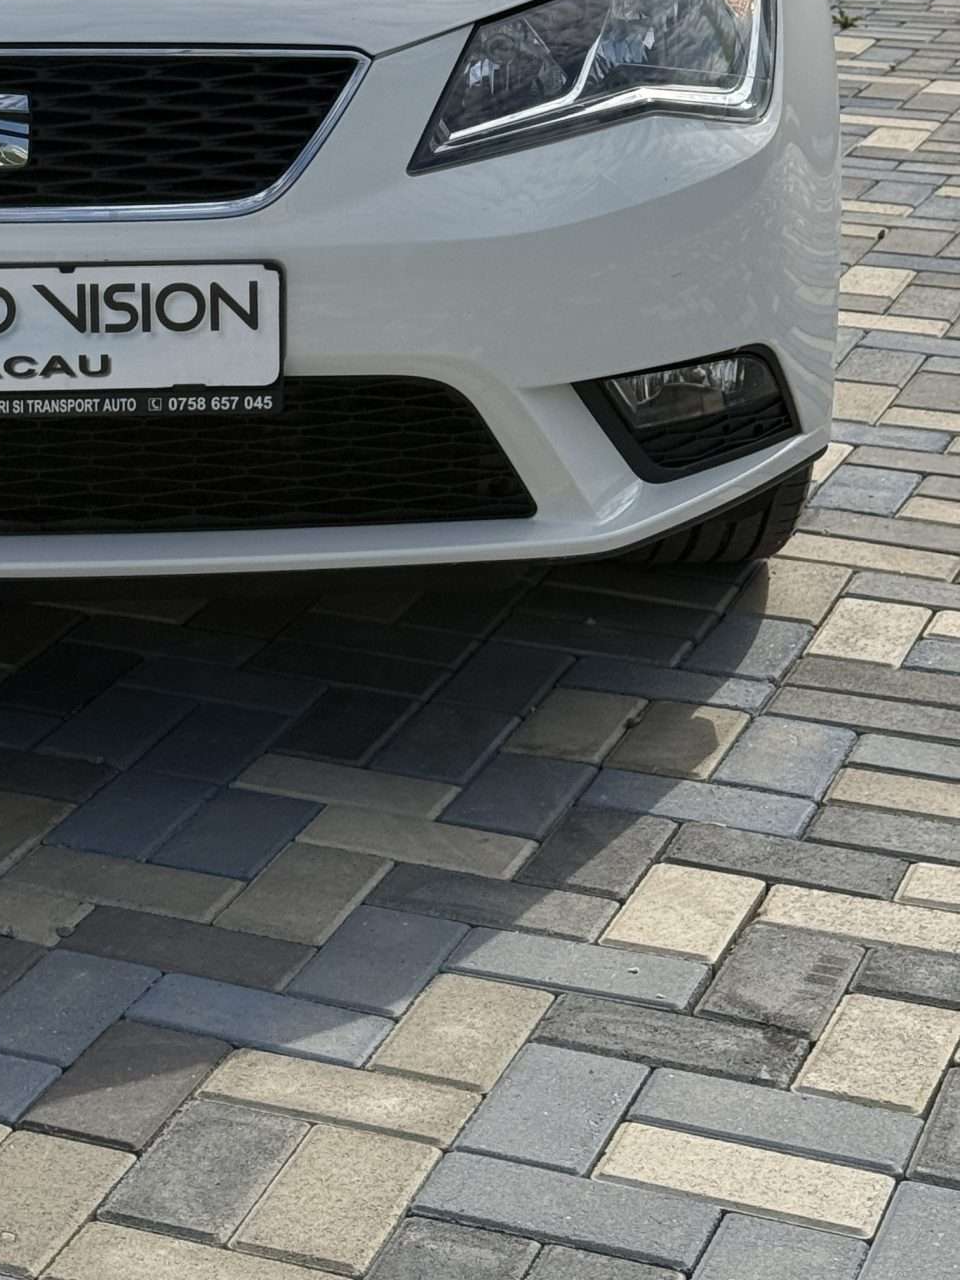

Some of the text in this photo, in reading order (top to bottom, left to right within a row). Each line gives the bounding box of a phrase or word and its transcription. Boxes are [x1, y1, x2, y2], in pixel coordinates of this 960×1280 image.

[32, 279, 259, 334] VISION
[12, 400, 24, 413] SI
[26, 399, 101, 413] TRANSPORT
[102, 398, 137, 412] AUTO
[167, 397, 207, 411] 0758
[210, 396, 239, 411] 657
[243, 396, 273, 410] 045
